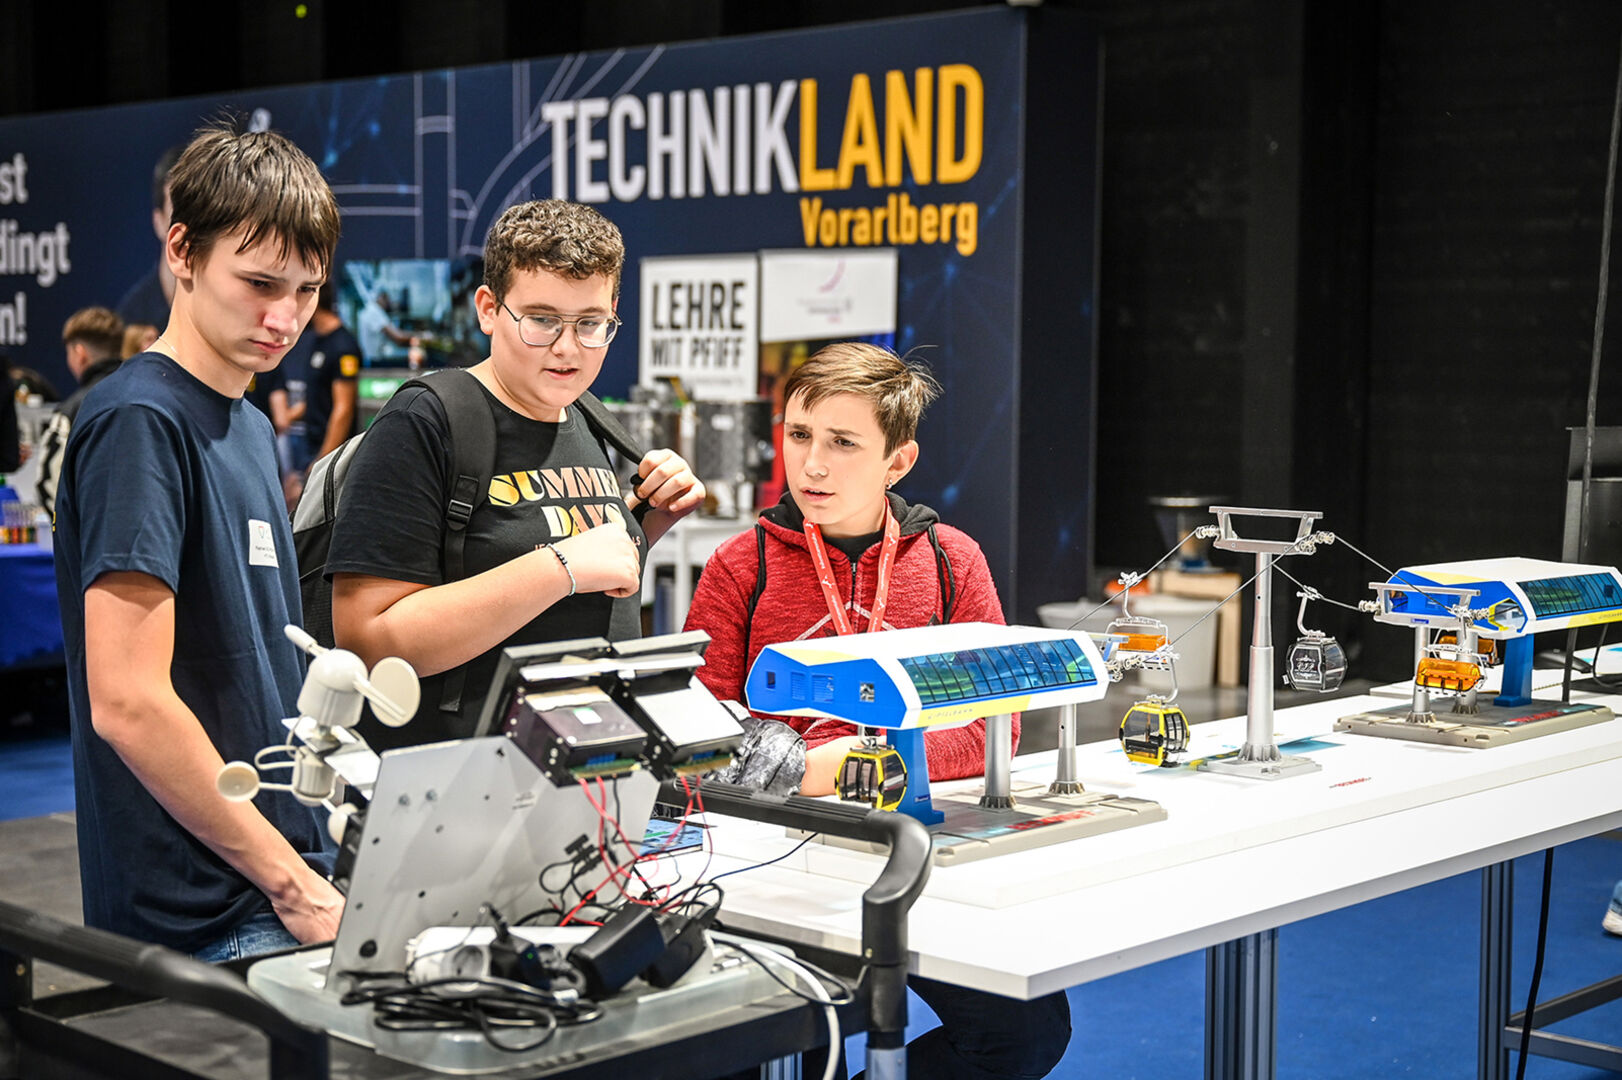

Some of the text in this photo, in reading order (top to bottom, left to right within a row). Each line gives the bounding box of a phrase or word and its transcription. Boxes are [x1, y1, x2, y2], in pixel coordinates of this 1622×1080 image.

[541, 63, 984, 202] TECHNIKLAND
[801, 193, 977, 256] Vorarlberg
[652, 280, 745, 331] LEHRE
[690, 335, 743, 369] PFIFF
